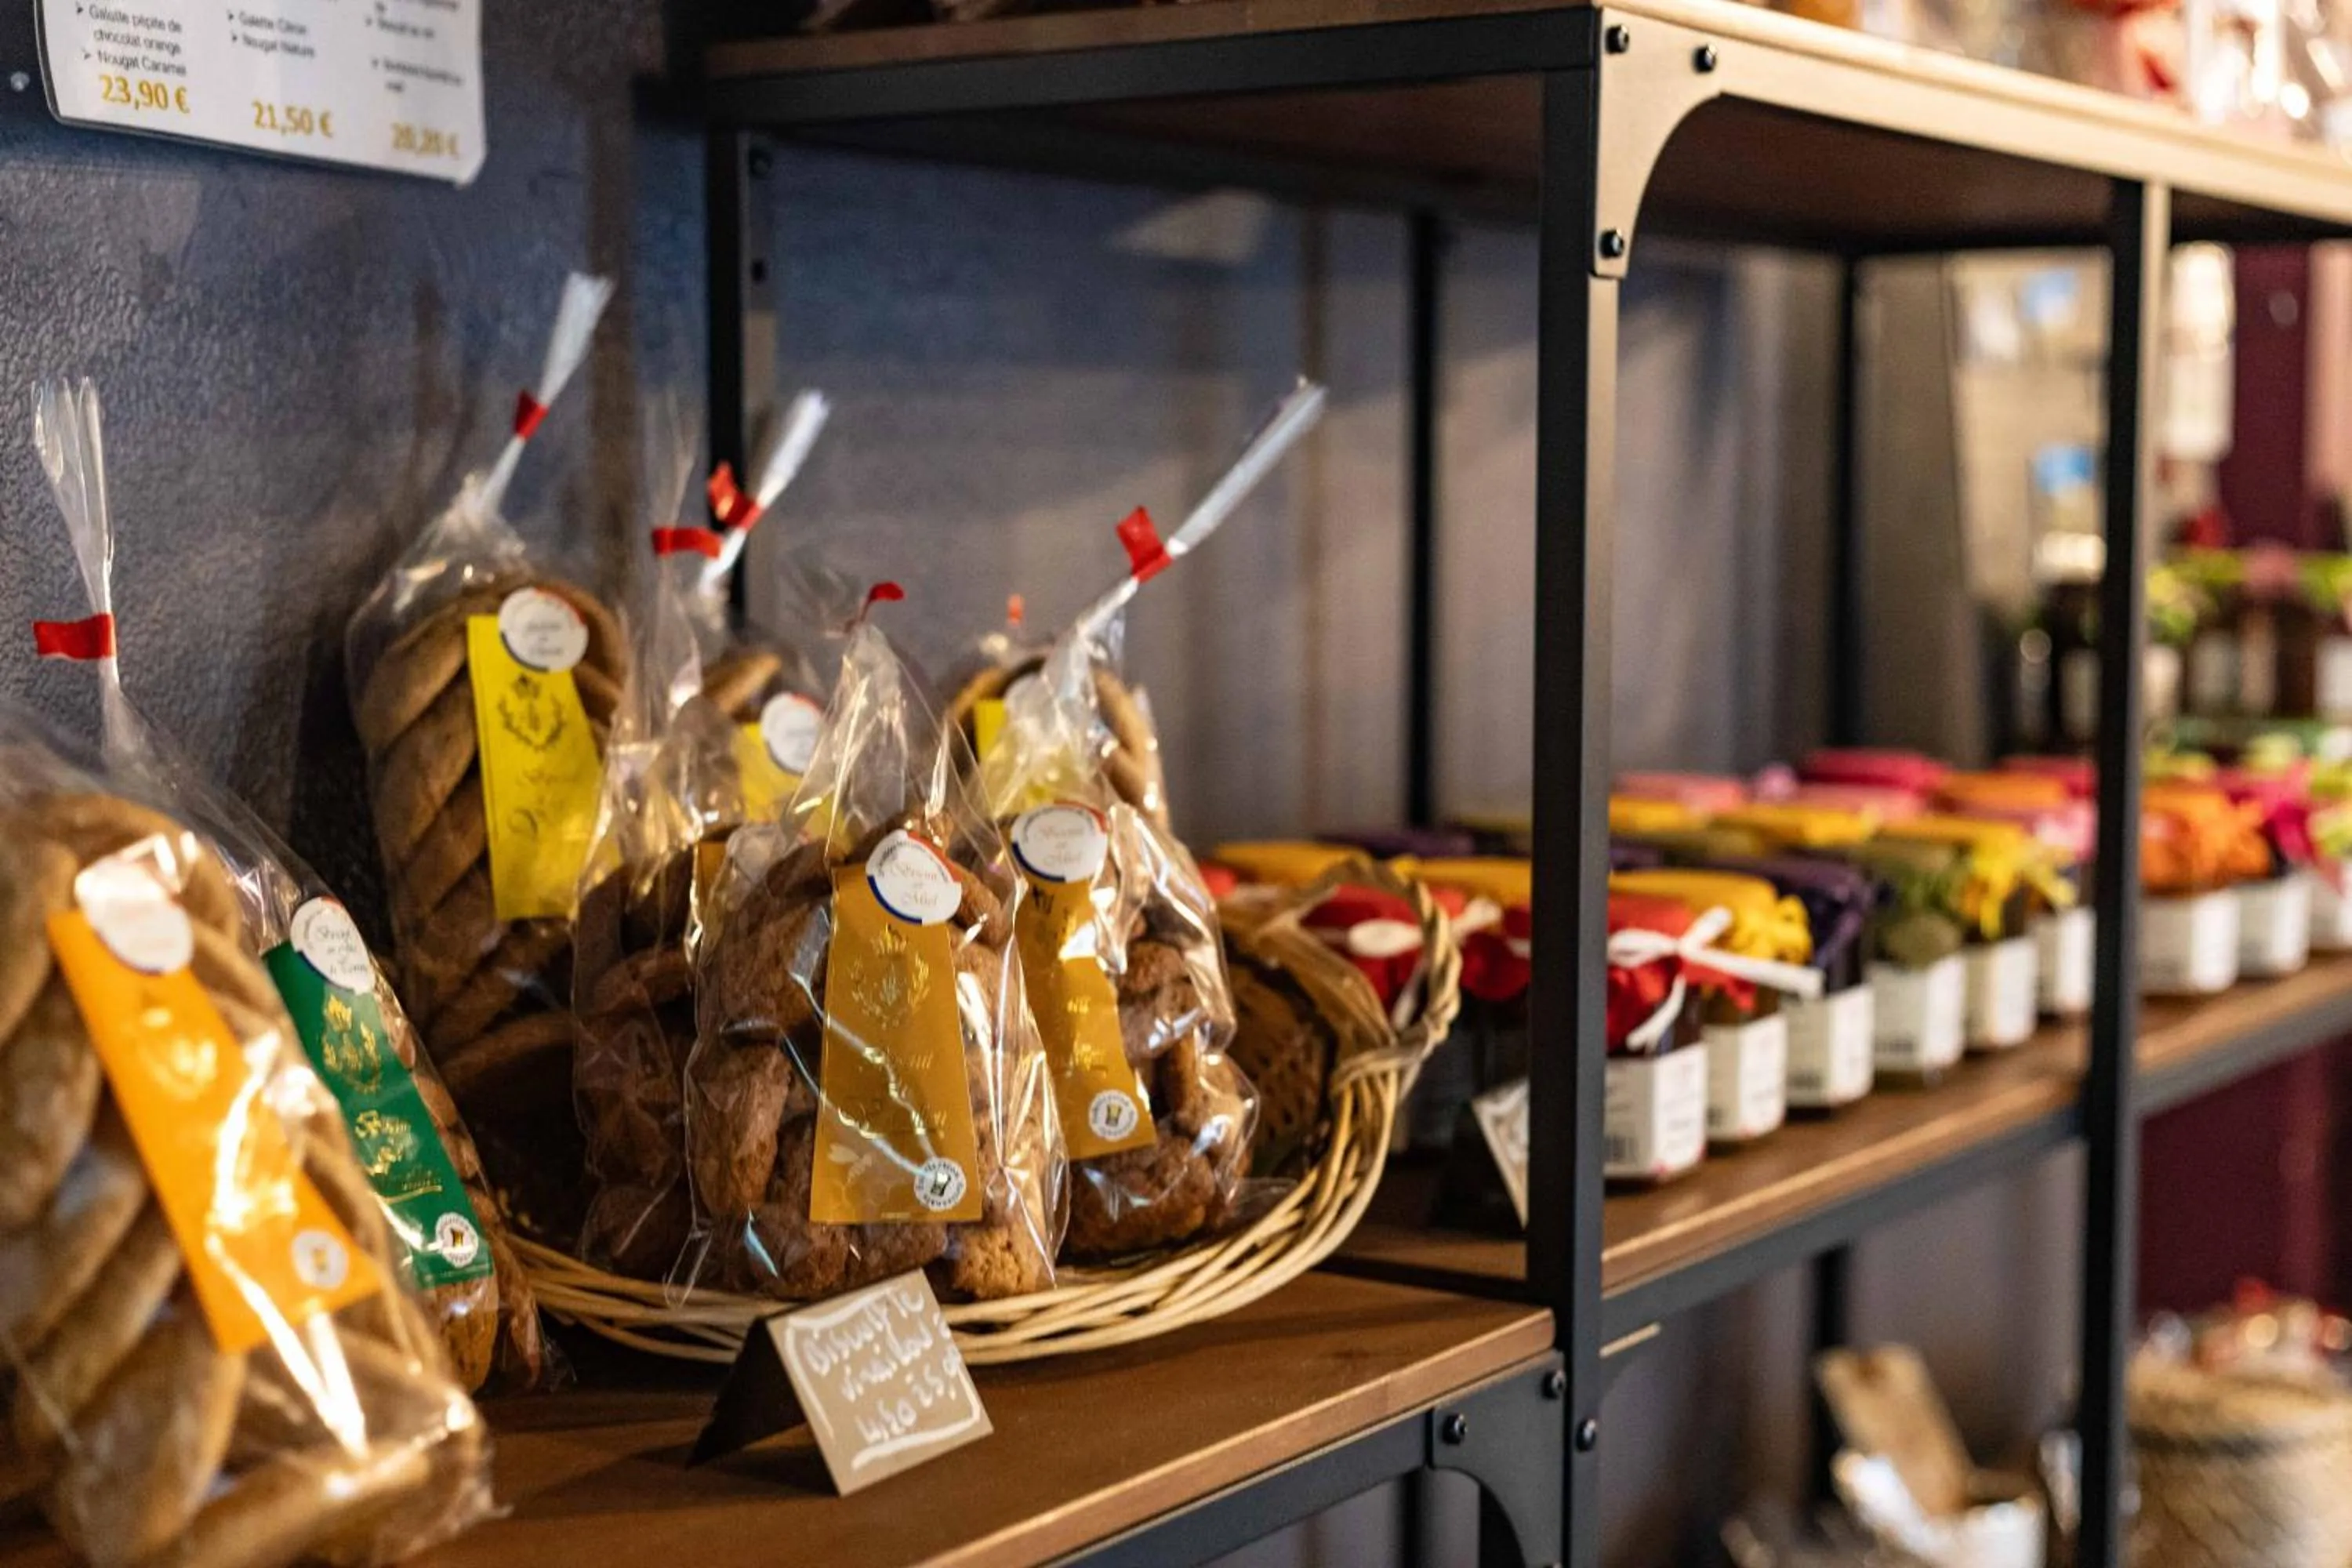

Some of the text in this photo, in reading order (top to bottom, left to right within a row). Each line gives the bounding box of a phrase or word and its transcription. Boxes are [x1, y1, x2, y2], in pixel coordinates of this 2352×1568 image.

[97, 49, 140, 71] Nougat
[99, 74, 191, 114] 23,90 €
[252, 98, 314, 136] 21,50
